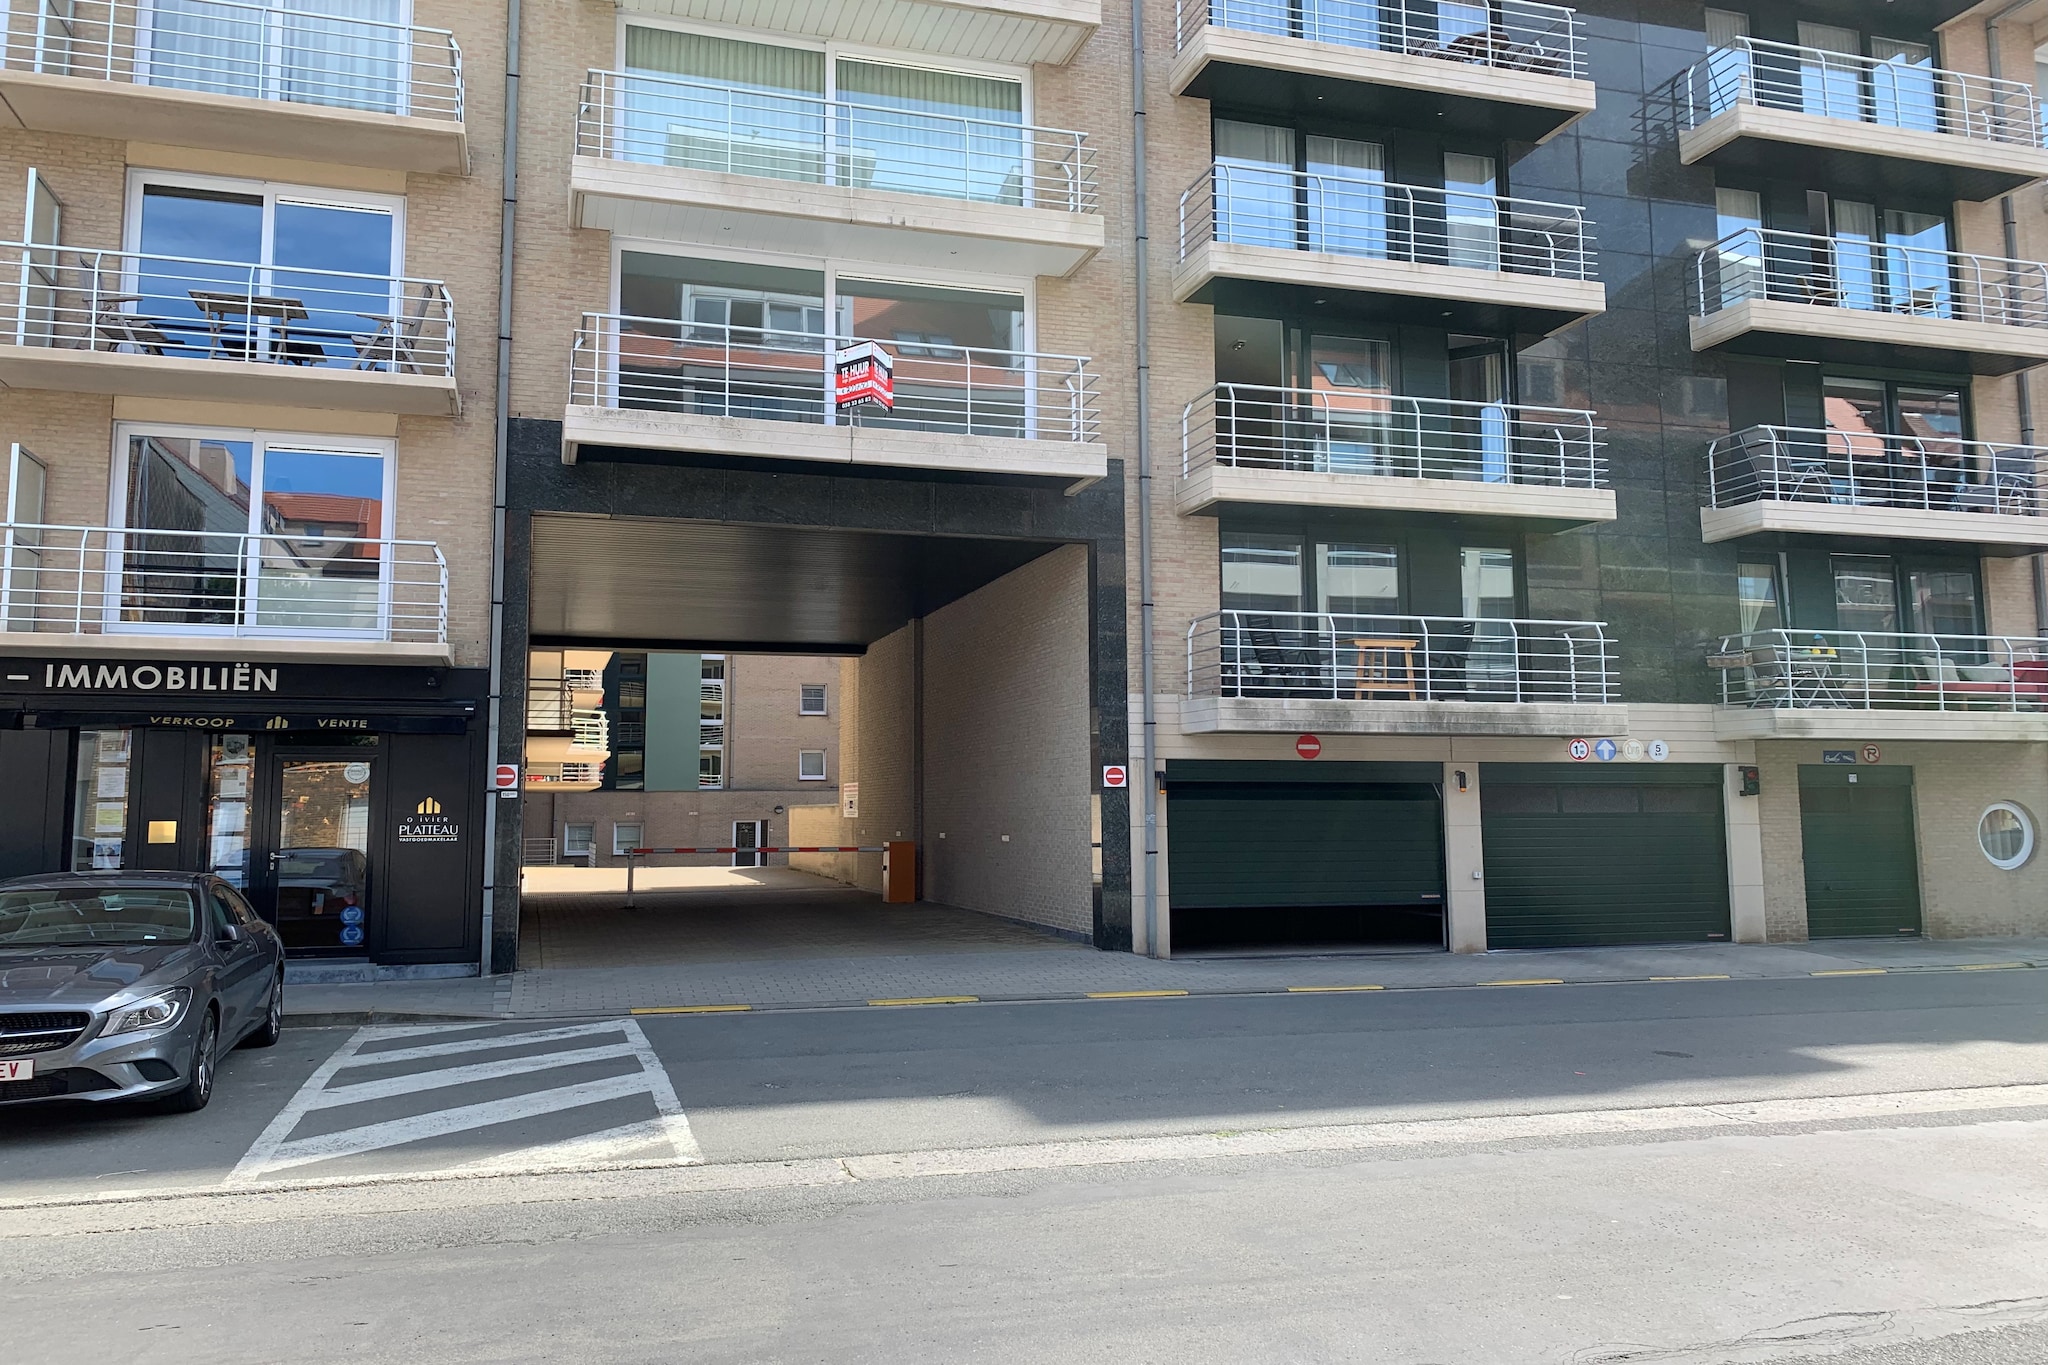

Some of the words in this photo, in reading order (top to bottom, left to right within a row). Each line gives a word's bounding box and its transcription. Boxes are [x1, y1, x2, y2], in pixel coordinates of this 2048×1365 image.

[841, 367, 849, 379] TE
[850, 361, 869, 377] HUUR
[45, 662, 278, 692] IMMOBILIËN
[150, 716, 235, 728] VERKOOP
[317, 718, 368, 729] VENTE
[1655, 745, 1661, 753] 5
[399, 825, 458, 834] PLATTEAU
